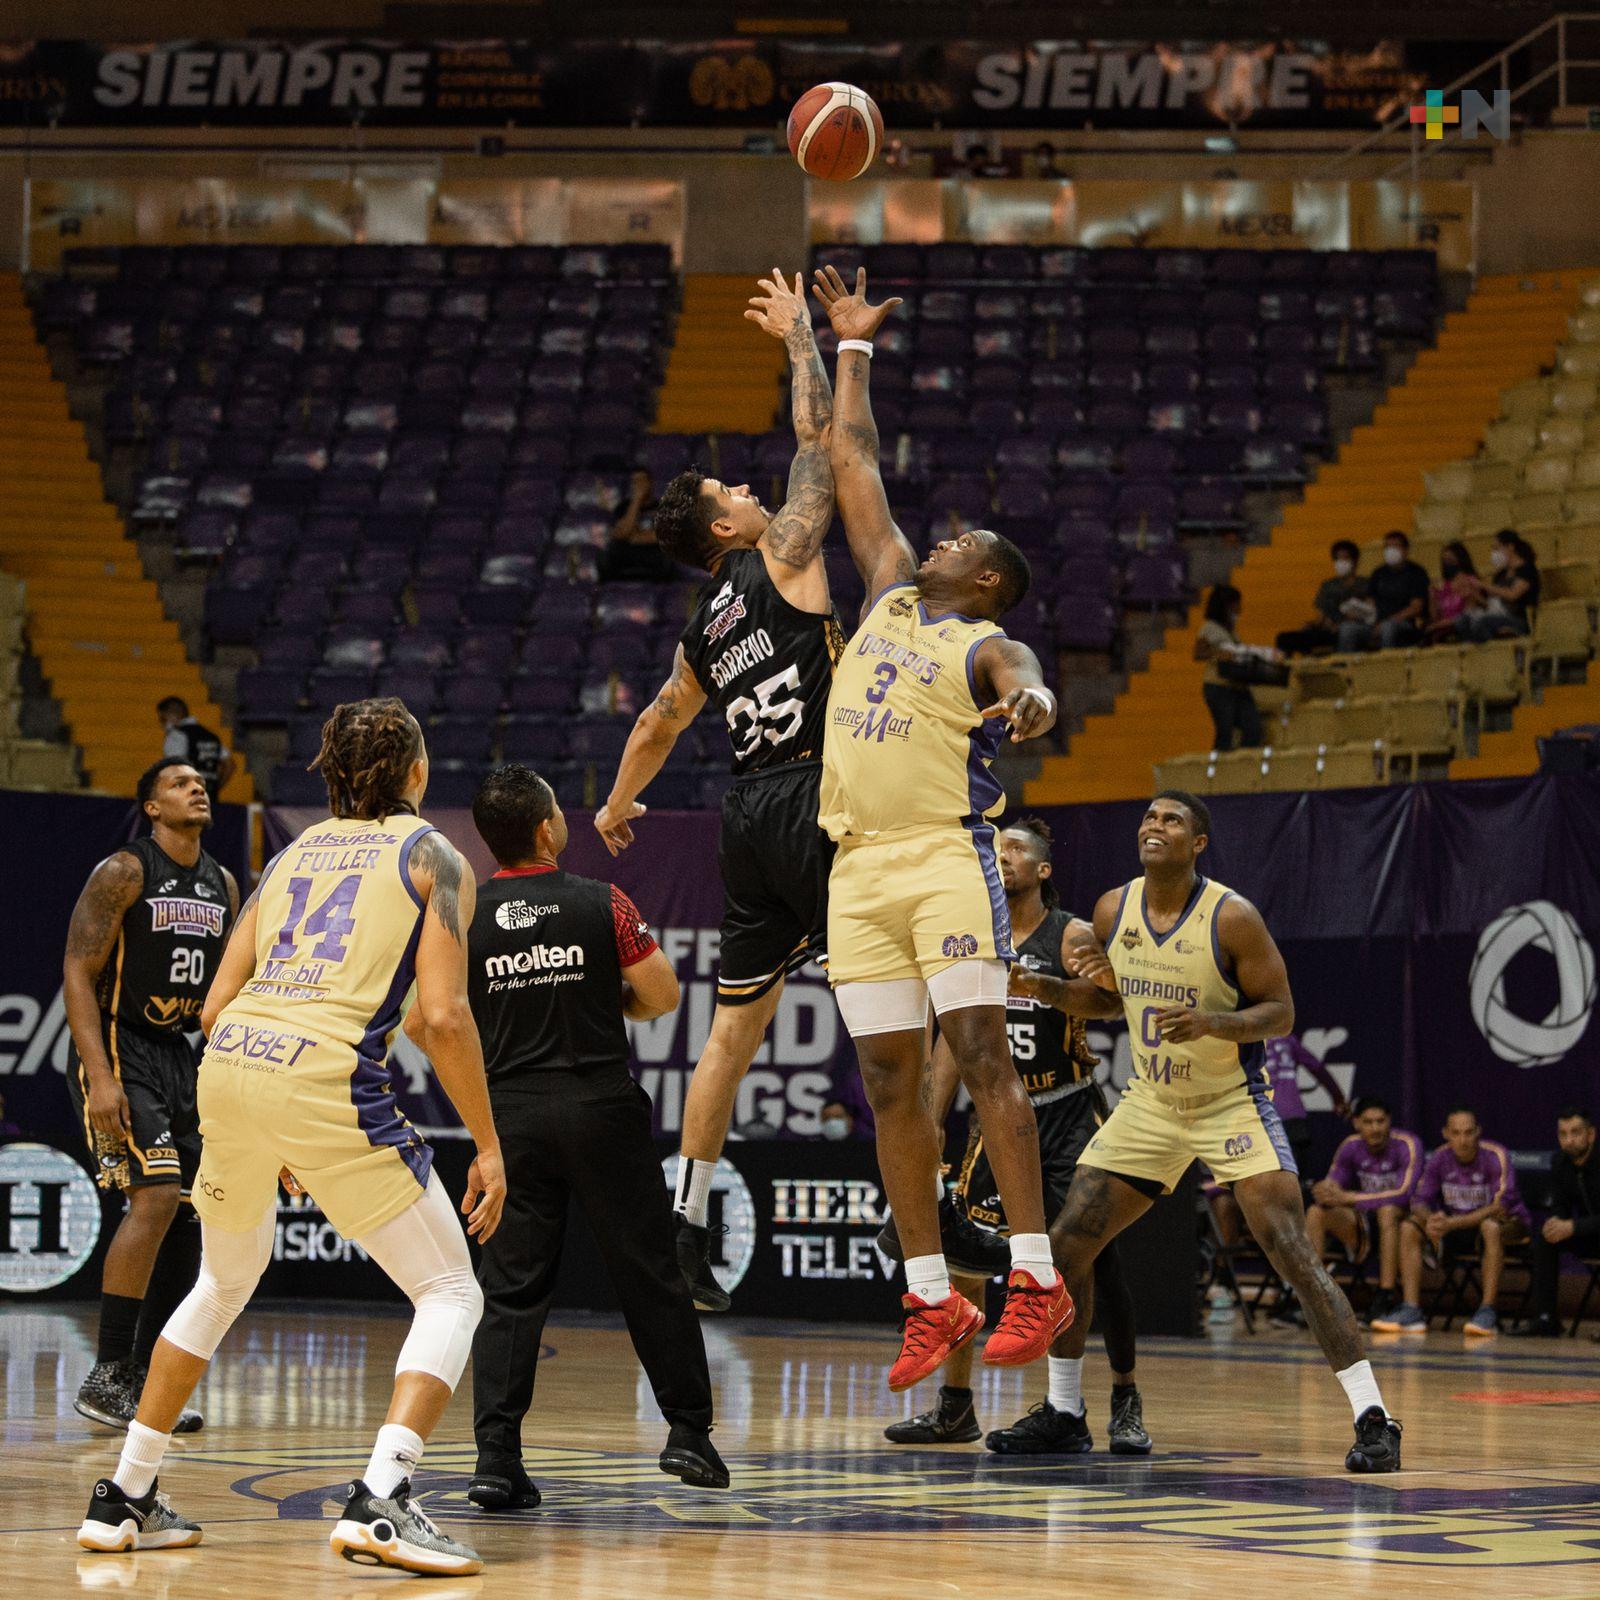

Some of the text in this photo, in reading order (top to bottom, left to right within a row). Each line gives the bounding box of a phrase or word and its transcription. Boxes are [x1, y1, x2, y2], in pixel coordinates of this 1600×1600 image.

[93, 50, 430, 108] SIEMPRE
[972, 52, 1313, 110] SIEMPRE
[710, 627, 775, 690] BARRENO
[856, 632, 944, 688] DORADOS
[865, 660, 898, 705] 3
[726, 663, 804, 762] 35
[298, 832, 400, 849] alsuper
[294, 848, 381, 873] FULLER
[155, 900, 221, 933] HALCONES
[269, 873, 363, 964] 14
[508, 899, 527, 909] LIGA
[510, 916, 537, 930] LNBP
[169, 946, 205, 986] 20
[260, 960, 326, 985] Mobil
[484, 944, 585, 979] molten
[1136, 958, 1186, 975] INTERCERAMIC
[487, 970, 585, 994] For the real game
[1120, 976, 1199, 1009] DORADOS
[205, 1022, 318, 1068] MEXBET
[1141, 1006, 1163, 1048] 0
